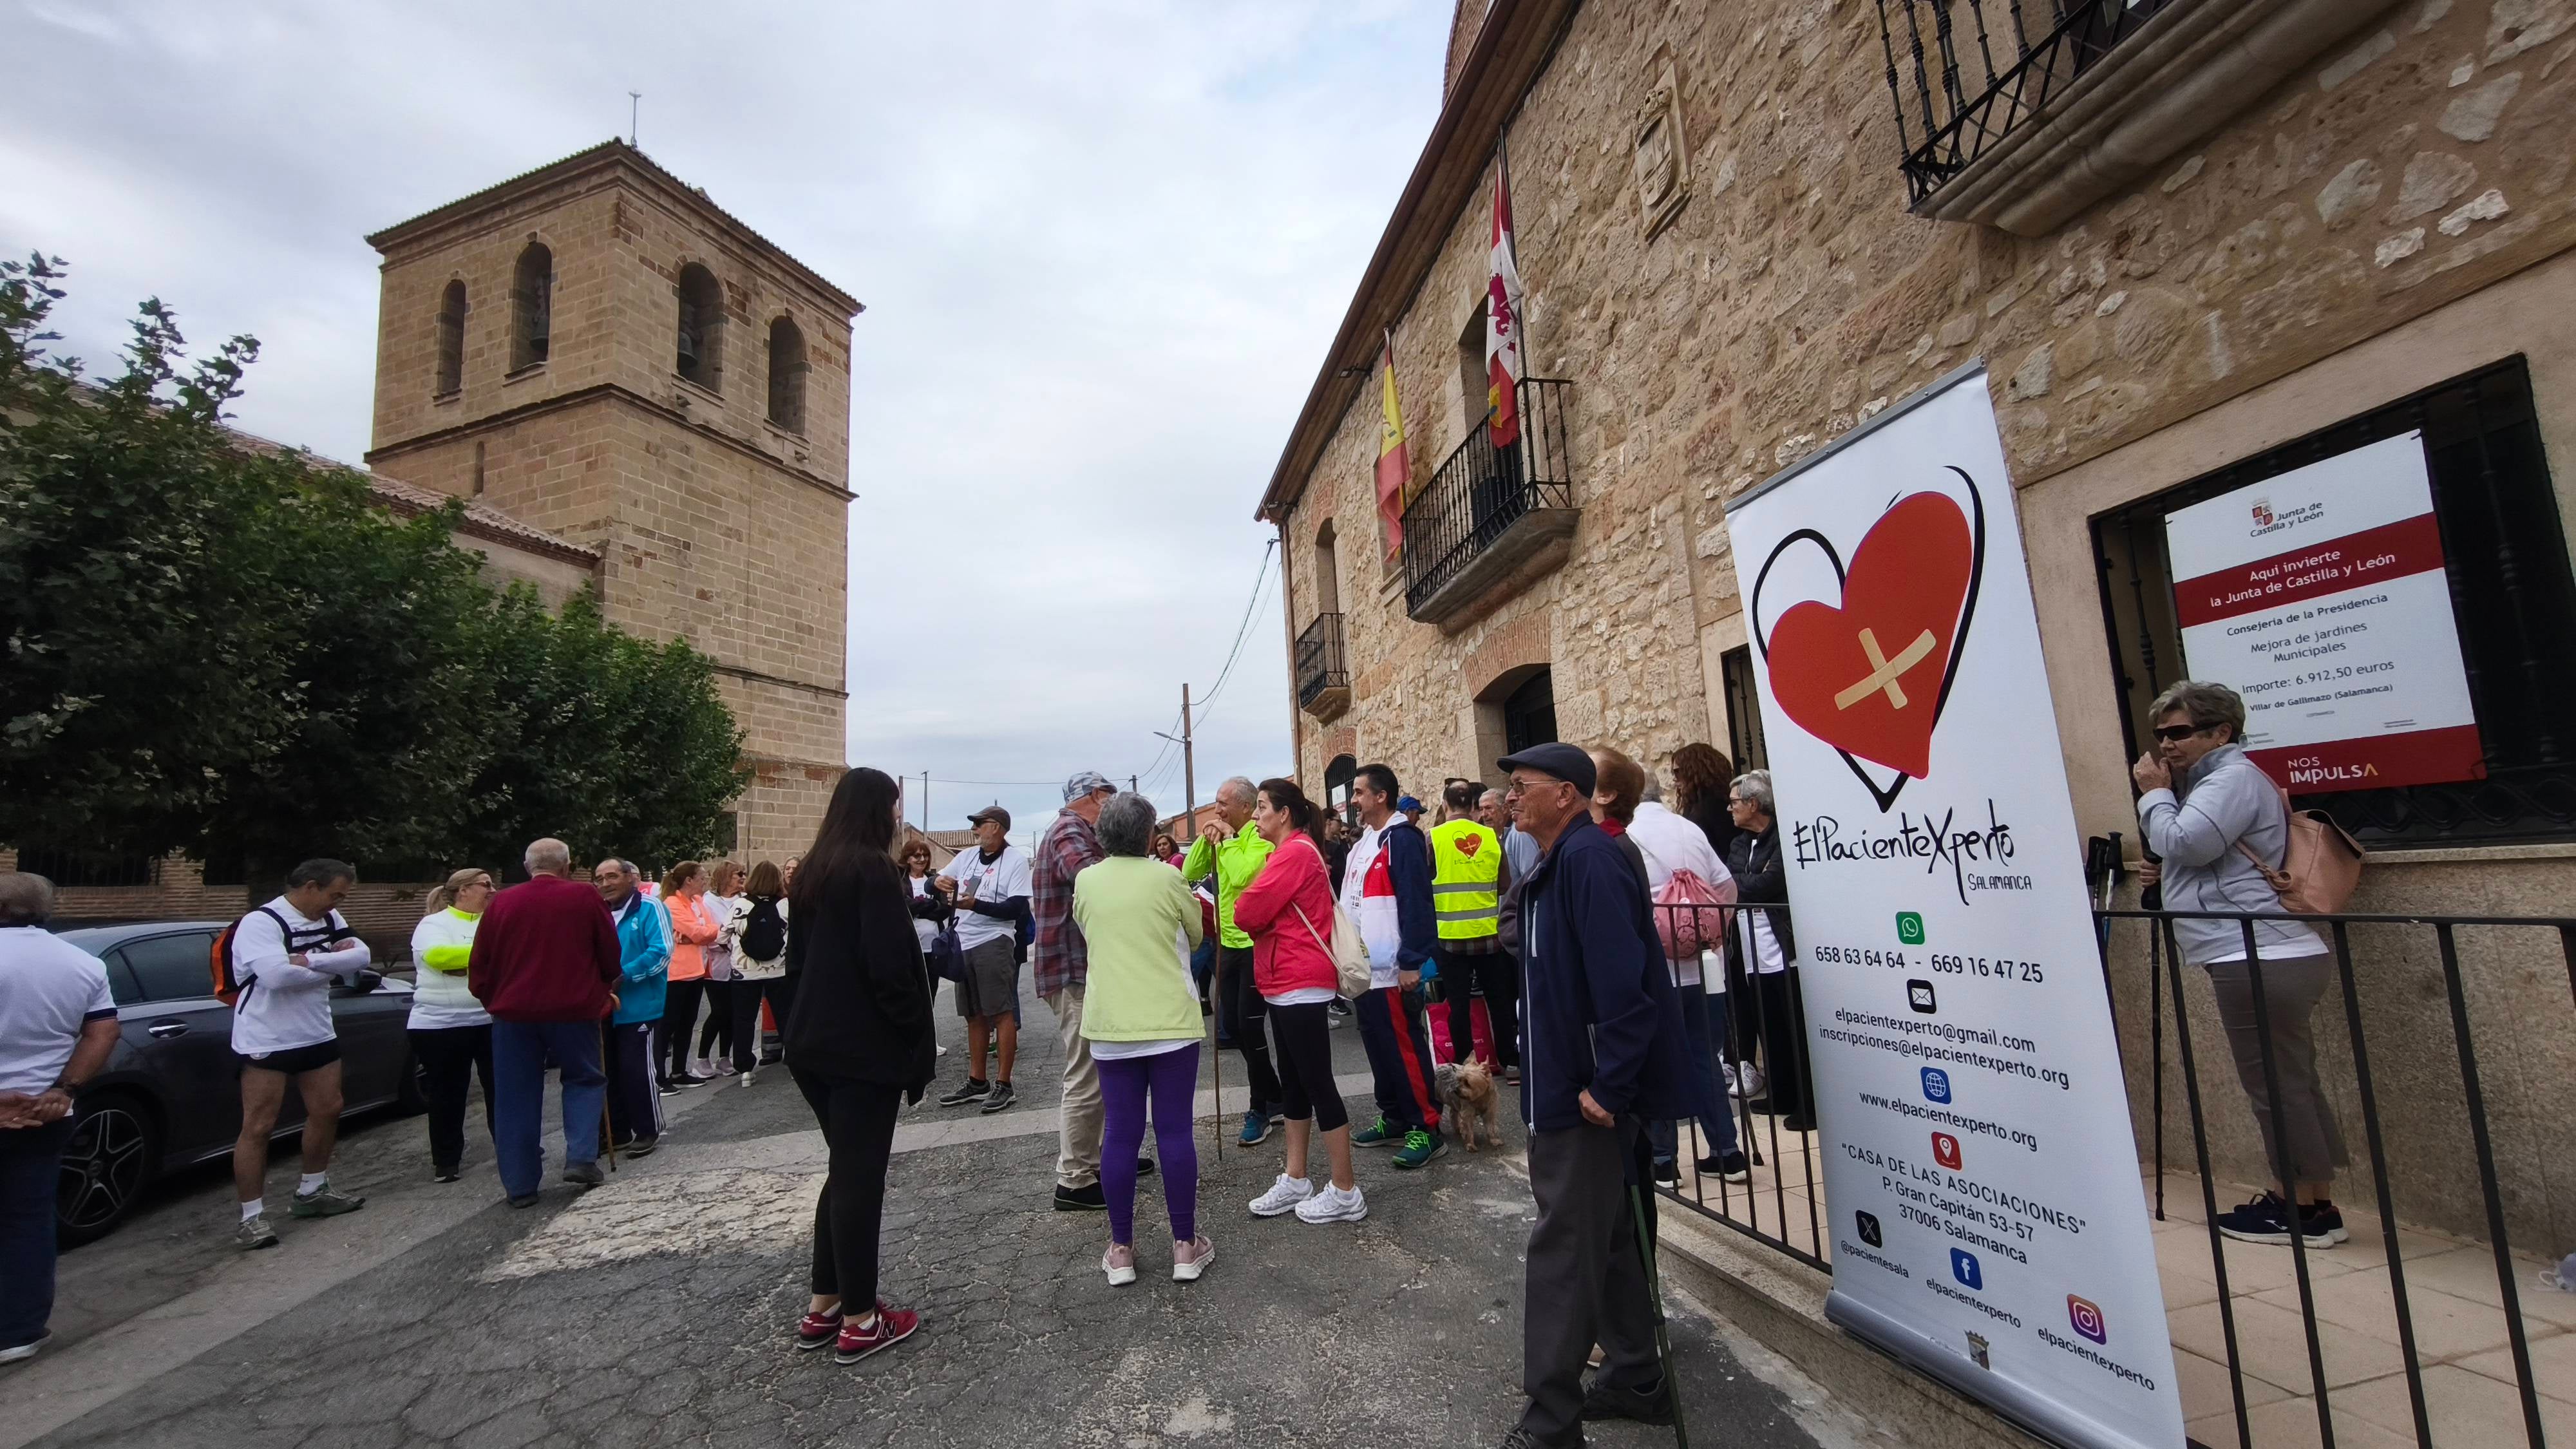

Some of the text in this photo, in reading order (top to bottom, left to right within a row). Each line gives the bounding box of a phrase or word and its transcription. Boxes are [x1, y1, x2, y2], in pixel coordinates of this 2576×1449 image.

[2250, 511, 2324, 537] Castilla y León
[2277, 502, 2322, 521] Junta de
[2210, 553, 2396, 607] la Junta de Castilla y León
[2249, 549, 2340, 582] Aqui invierte
[2287, 612, 2300, 623] de
[2303, 609, 2313, 620] la
[2317, 593, 2388, 616] Presidencia
[2251, 621, 2367, 653] Mejora de jardines
[2274, 641, 2346, 663] Municipales
[2242, 659, 2394, 694] Importe: 6.912,50 euros
[2249, 684, 2393, 712] Villar de Gallimazo (Salamanca)
[2288, 757, 2320, 768] NOS
[1815, 946, 1839, 963] 658
[1845, 948, 1861, 965] 63
[1865, 951, 1882, 967] 64
[1886, 952, 1905, 968] 64
[1932, 954, 1962, 974] 669
[1969, 958, 1989, 976] 16
[1994, 960, 2012, 980] 47
[2021, 962, 2043, 983] 25
[1835, 1007, 2035, 1053] elpacientexperto@gmail.com
[1819, 1025, 2070, 1090] inscripciones@elpacientexperto.org
[1859, 1092, 2038, 1151] www.elpacientexperto.org
[1888, 1157, 1906, 1175] DE
[1911, 1164, 1940, 1186] LAS
[1883, 1176, 2034, 1242] P. Gran Capitán 53-57
[1899, 1204, 2027, 1264] 37006 Salamanca
[1841, 1241, 1909, 1278] @pacientesala
[1926, 1278, 2021, 1329] elpacientexperto
[2038, 1327, 2155, 1392] elpacientexperto
